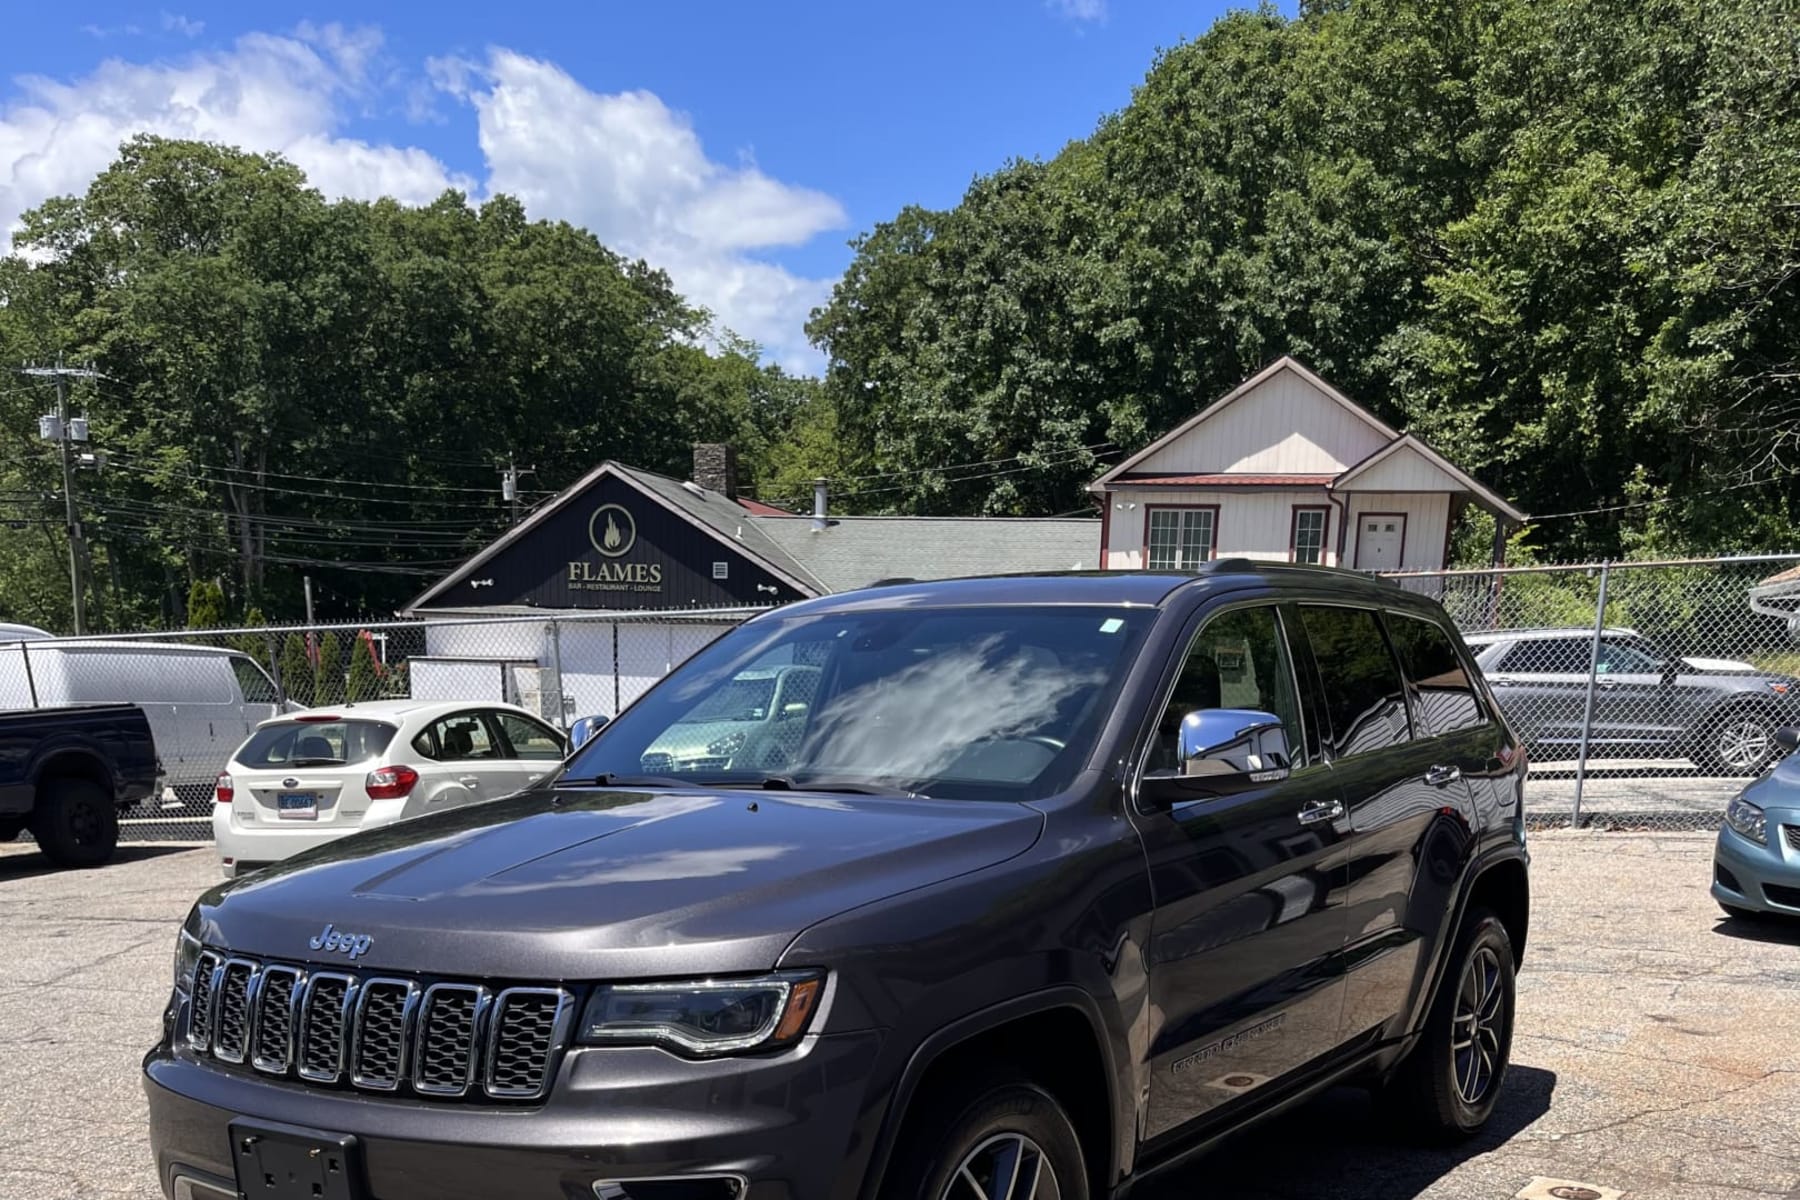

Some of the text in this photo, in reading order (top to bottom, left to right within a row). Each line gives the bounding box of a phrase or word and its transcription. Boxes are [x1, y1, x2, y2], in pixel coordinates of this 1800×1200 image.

[568, 561, 662, 583] FLAMES
[568, 582, 661, 593] BAR RESTAURANT LOUNGE
[309, 923, 373, 960] Jeep
